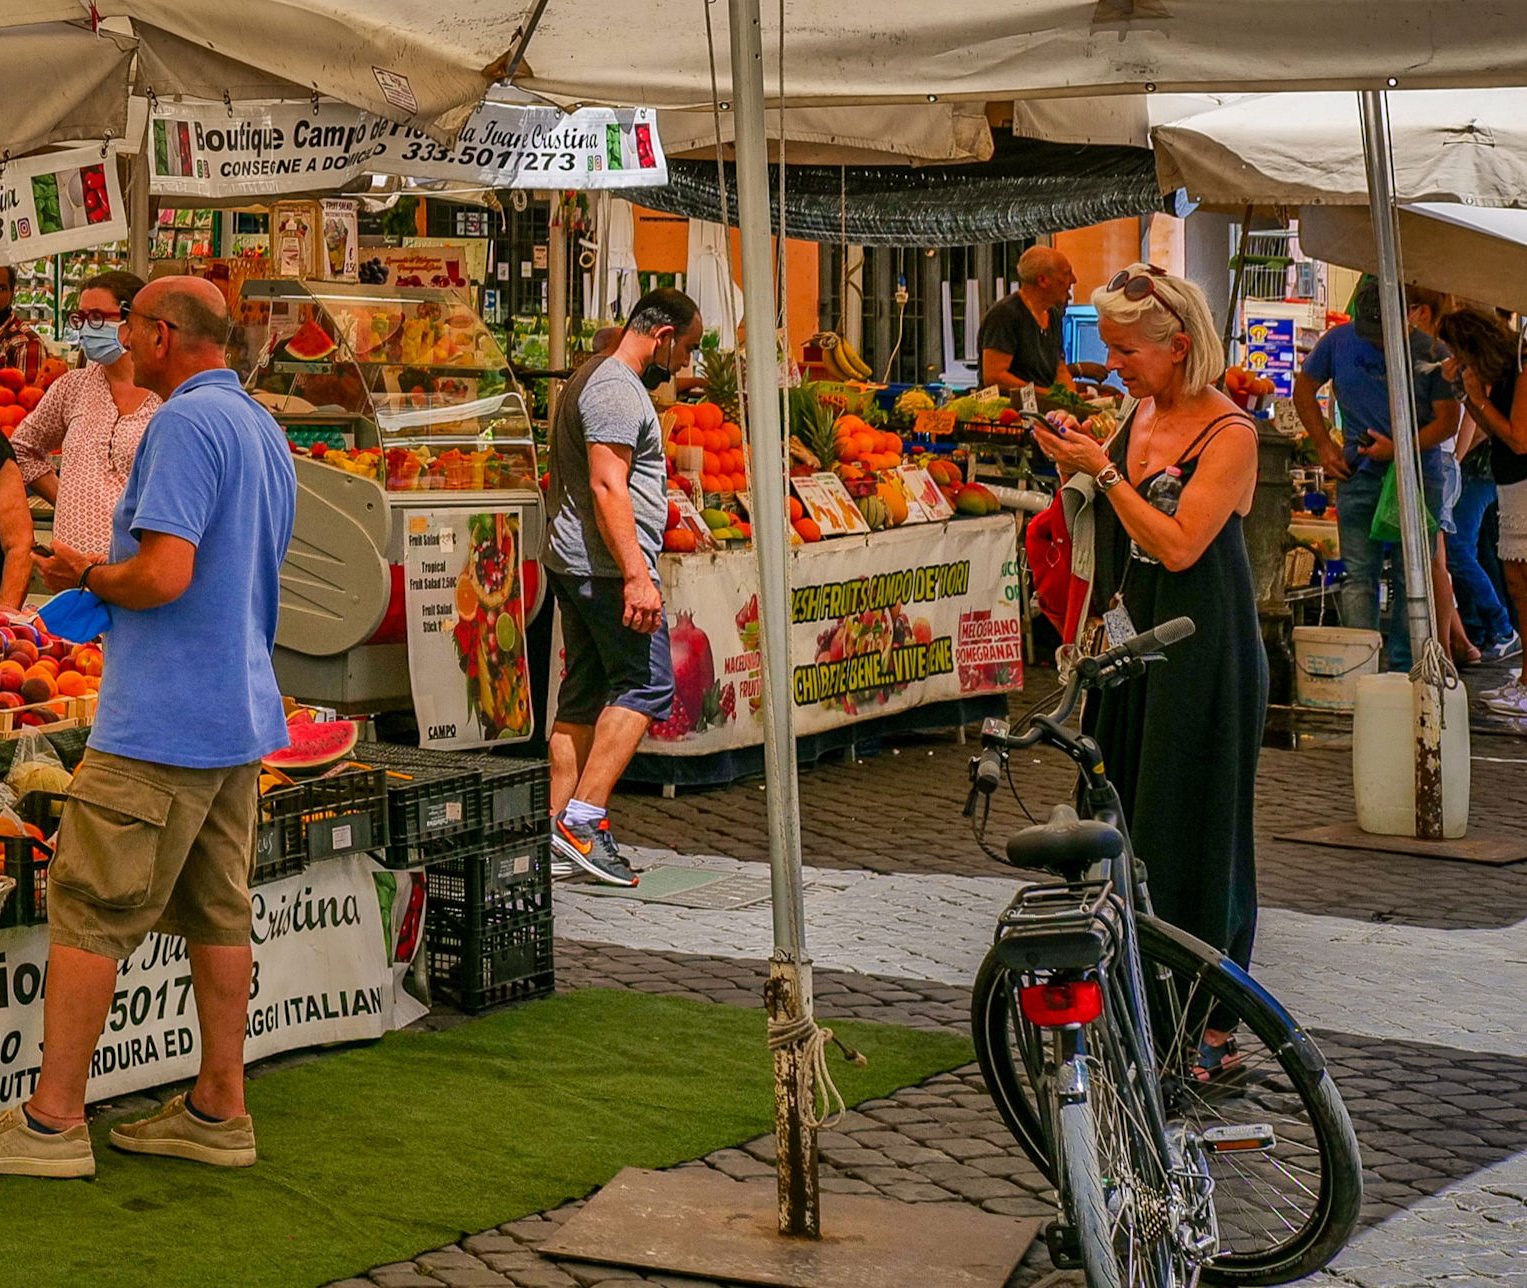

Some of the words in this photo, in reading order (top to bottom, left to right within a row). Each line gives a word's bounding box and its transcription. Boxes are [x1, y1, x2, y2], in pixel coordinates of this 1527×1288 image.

[194, 120, 285, 157] Boutique
[293, 119, 366, 153] Campo
[370, 118, 388, 139] de
[532, 124, 599, 150] Cristina
[220, 158, 301, 178] CONSEGNE
[306, 158, 317, 173] A
[401, 141, 576, 172] 333.5017273
[408, 534, 424, 547] Fruit
[421, 561, 446, 574] Tropical
[820, 577, 869, 619] FRUITS
[868, 569, 913, 610] CAMPO
[961, 618, 1020, 640] MELOGRANO
[955, 642, 1021, 665] POMEGRANAT
[793, 664, 820, 707] CHI
[427, 724, 457, 740] CAMPO
[250, 886, 361, 945] Cristina
[91, 1034, 159, 1080] RDURA
[163, 1027, 194, 1058] ED
[244, 1002, 279, 1040] AGGI
